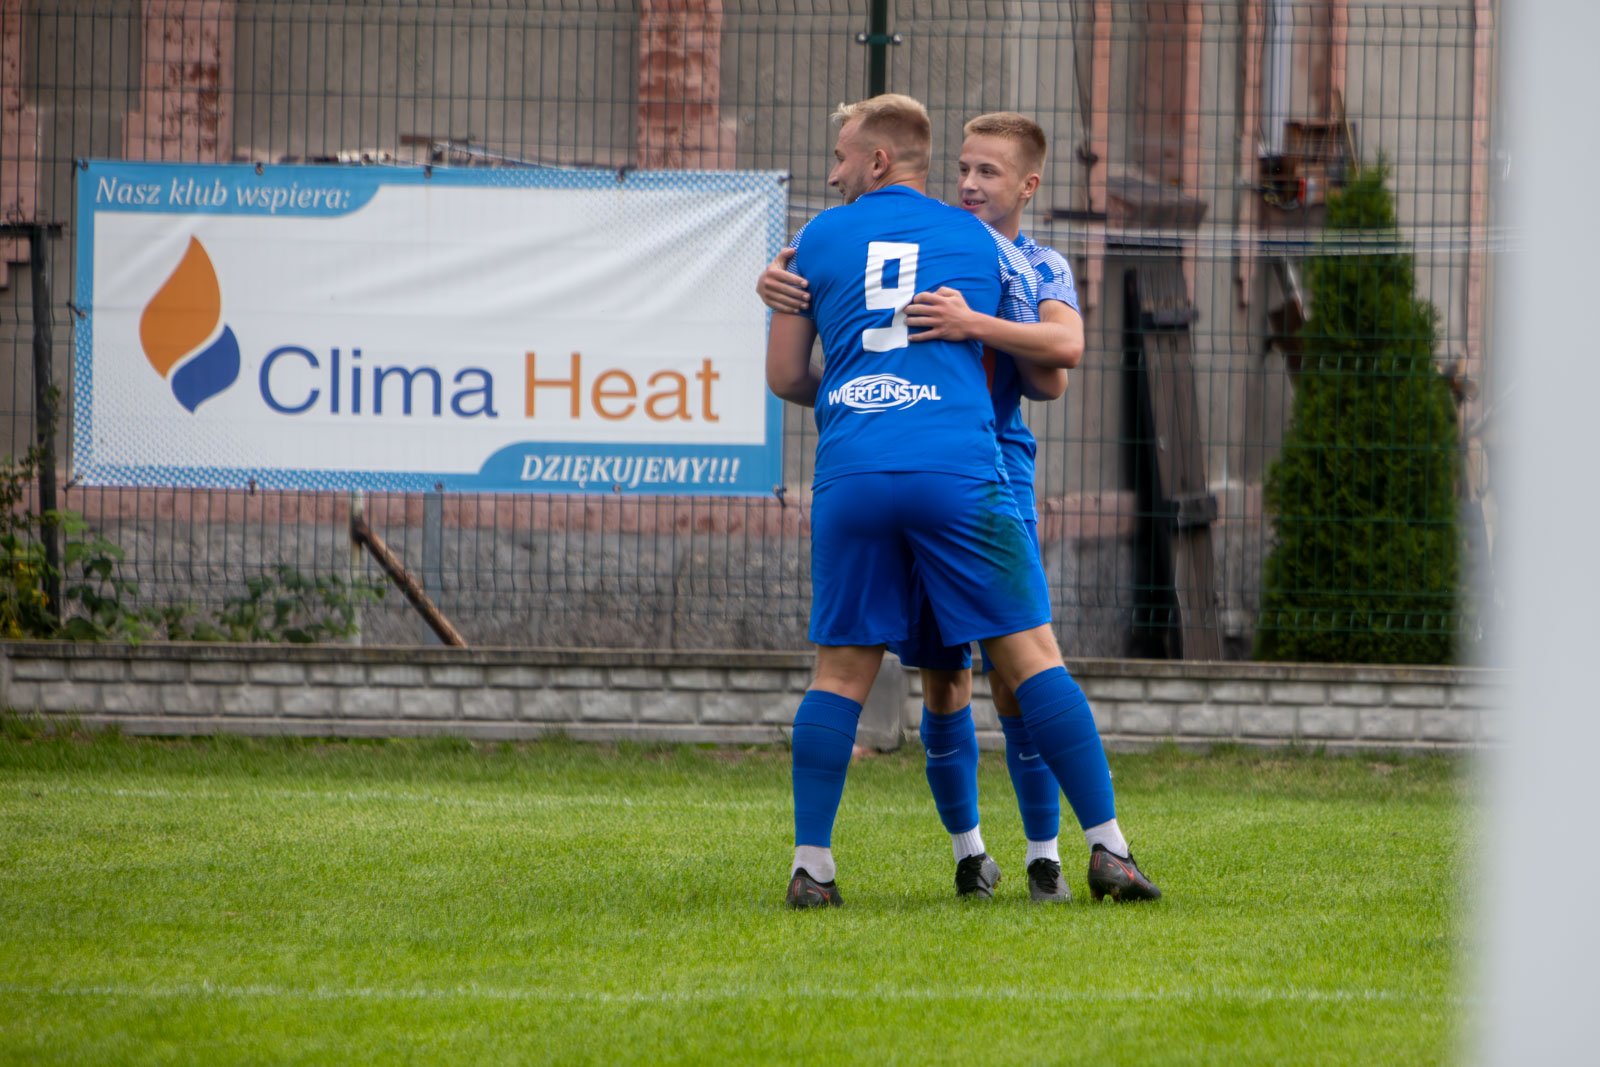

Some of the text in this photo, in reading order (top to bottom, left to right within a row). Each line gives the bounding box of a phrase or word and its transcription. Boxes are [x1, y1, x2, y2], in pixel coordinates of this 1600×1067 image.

[95, 176, 352, 214] Nasz klub wspiera:
[862, 241, 920, 352] 9
[258, 345, 721, 423] Clima Heat
[828, 384, 942, 406] WIERT-INSTAL
[519, 454, 741, 489] DZIĘKUJEMY!!!
